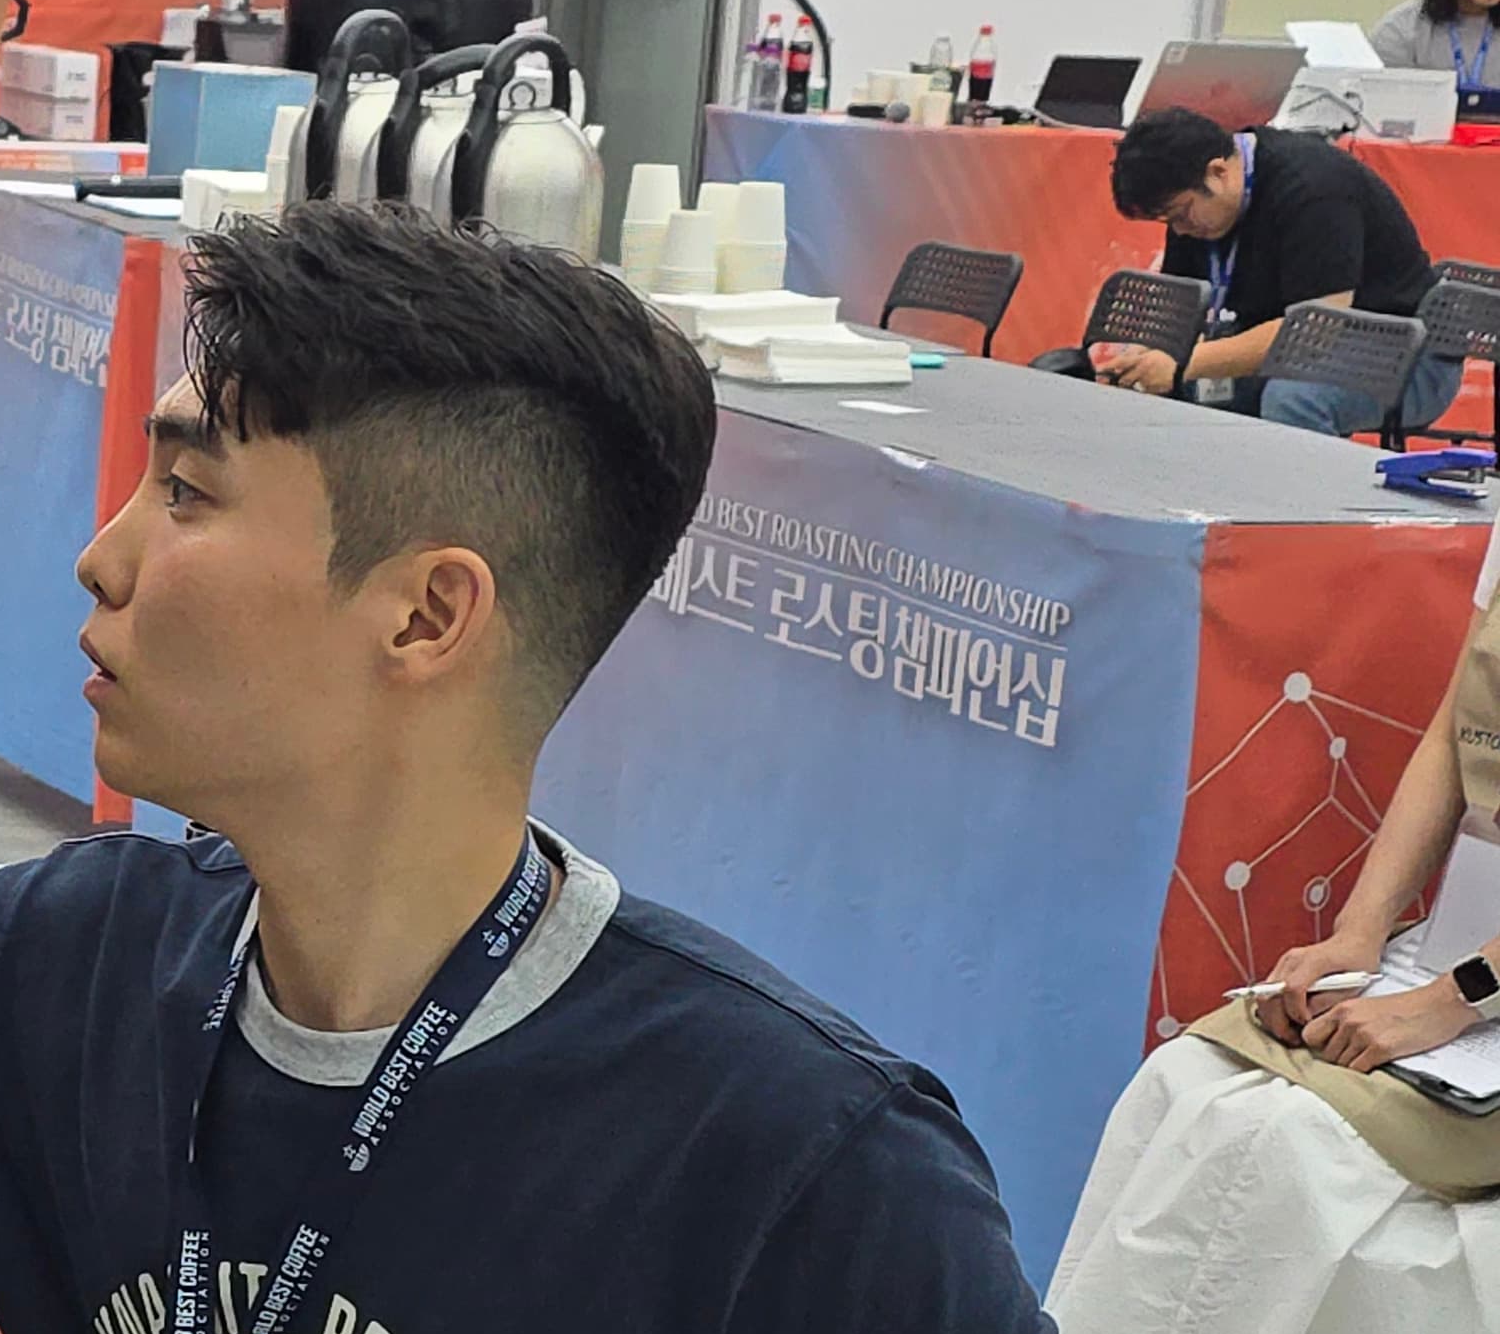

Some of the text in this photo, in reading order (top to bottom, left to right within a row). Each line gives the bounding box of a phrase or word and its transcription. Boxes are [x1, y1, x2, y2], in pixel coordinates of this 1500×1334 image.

[716, 496, 768, 540] BEST
[769, 513, 884, 575] ROASTING
[884, 547, 1071, 636] CHAMPIONSHIP
[764, 567, 888, 680] 로스팅
[891, 608, 1067, 747] 챔피언십
[352, 1000, 448, 1138] WORLD BEST COFFEE
[370, 1012, 459, 1146] ASSOCIATION
[174, 1288, 197, 1328] BEST
[179, 1230, 201, 1287] COFFEE
[264, 1275, 295, 1313] BEST
[280, 1223, 320, 1278] COFFEE
